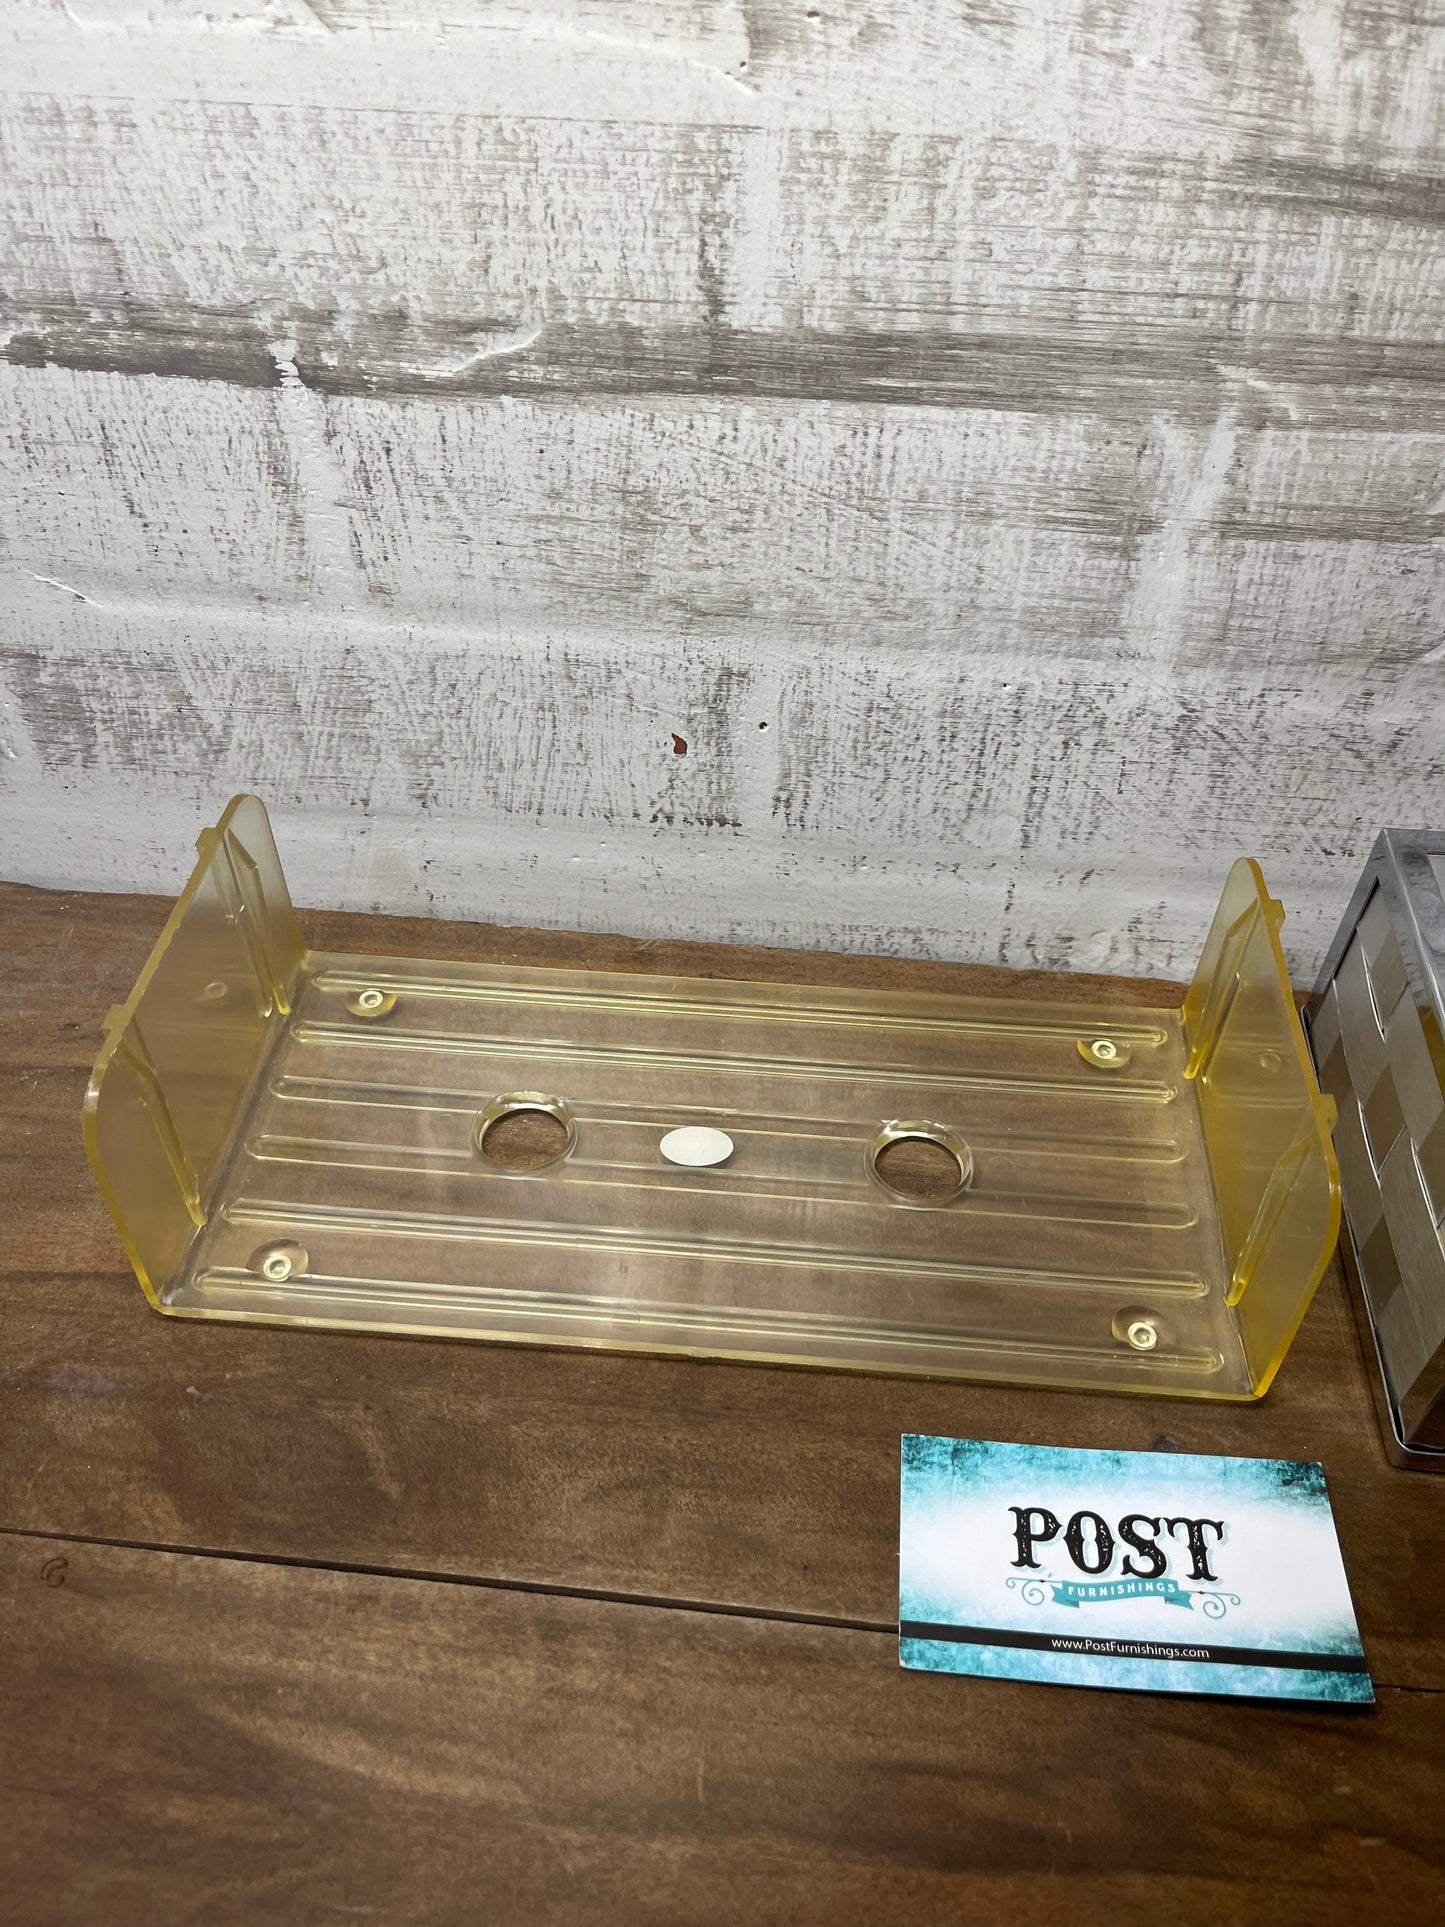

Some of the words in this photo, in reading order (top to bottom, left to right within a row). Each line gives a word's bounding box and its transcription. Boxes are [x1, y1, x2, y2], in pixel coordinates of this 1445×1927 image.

[1008, 1506, 1225, 1581] POST
[1067, 1582, 1176, 1597] FURNISHINGS
[1051, 1638, 1210, 1659] www.PostFurnishings.com
